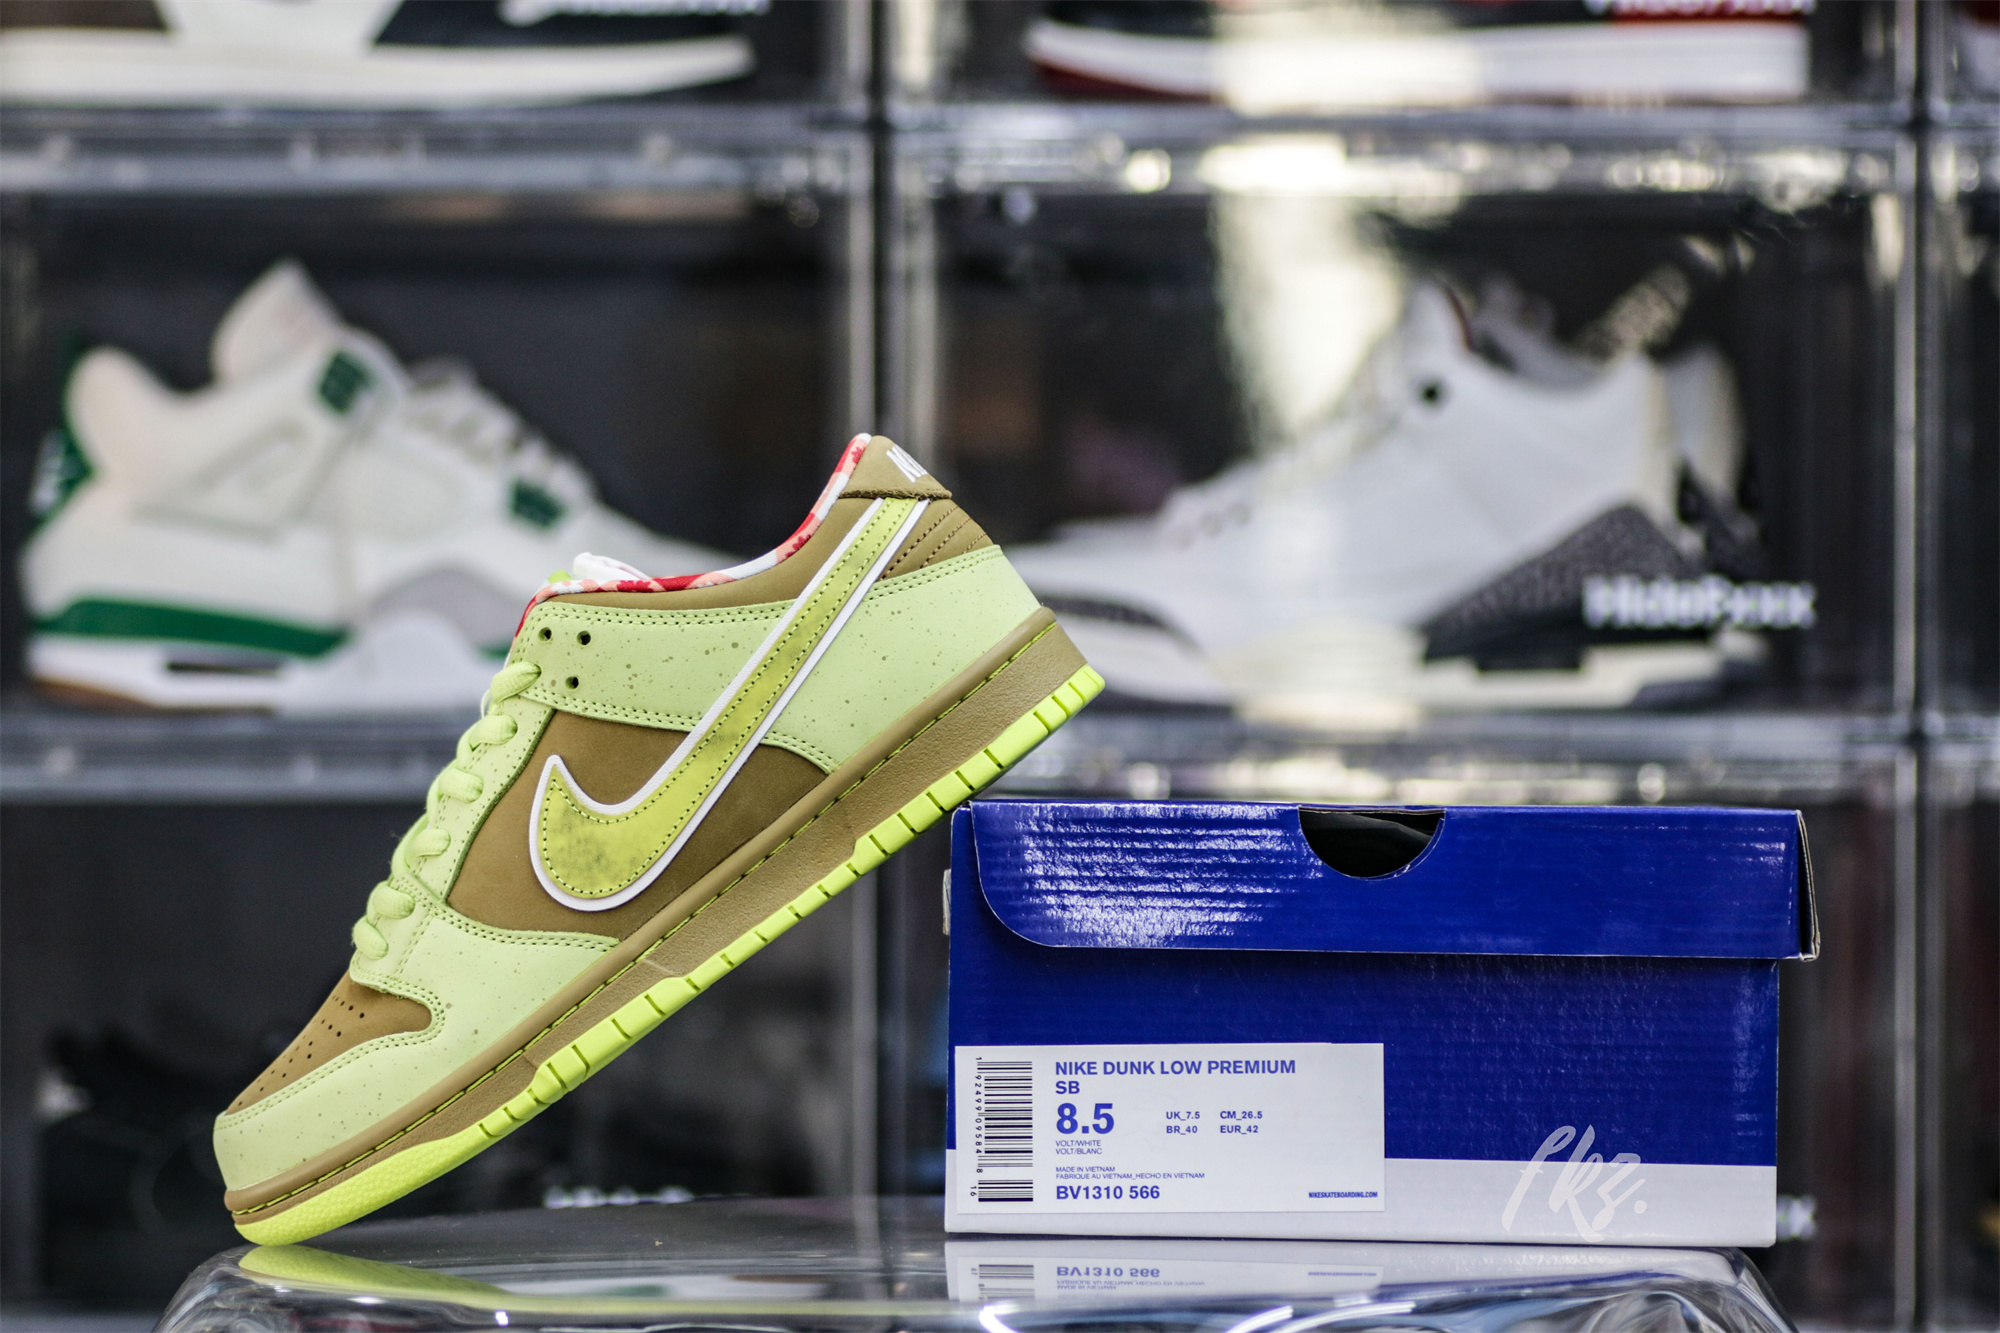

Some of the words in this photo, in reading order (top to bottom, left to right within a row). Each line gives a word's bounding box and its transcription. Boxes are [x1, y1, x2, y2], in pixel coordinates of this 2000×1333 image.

[1055, 1061, 1098, 1076] NIKE
[1103, 1060, 1156, 1076] DUNK
[1160, 1060, 1203, 1075] LOW
[1207, 1059, 1296, 1075] PREMIUM
[974, 1074, 983, 1112] 92499
[1055, 1080, 1081, 1095] SB
[1056, 1102, 1115, 1135] 8.5
[1166, 1110, 1201, 1122] UK_7.5
[1219, 1110, 1263, 1121] CM_26.5
[974, 1117, 983, 1155] 09584
[1166, 1125, 1198, 1136] BR_40
[1219, 1124, 1259, 1135] EUR_42
[1055, 1139, 1102, 1148] VOLT/WHITE
[1055, 1147, 1103, 1156] VOLT/BLANC
[1162, 1172, 1173, 1180] EN
[970, 1185, 977, 1197] 16
[1056, 1185, 1124, 1200] BV1310
[1128, 1184, 1161, 1200] 566
[1308, 1191, 1379, 1199] NIKESKATEBOARDING.COM
